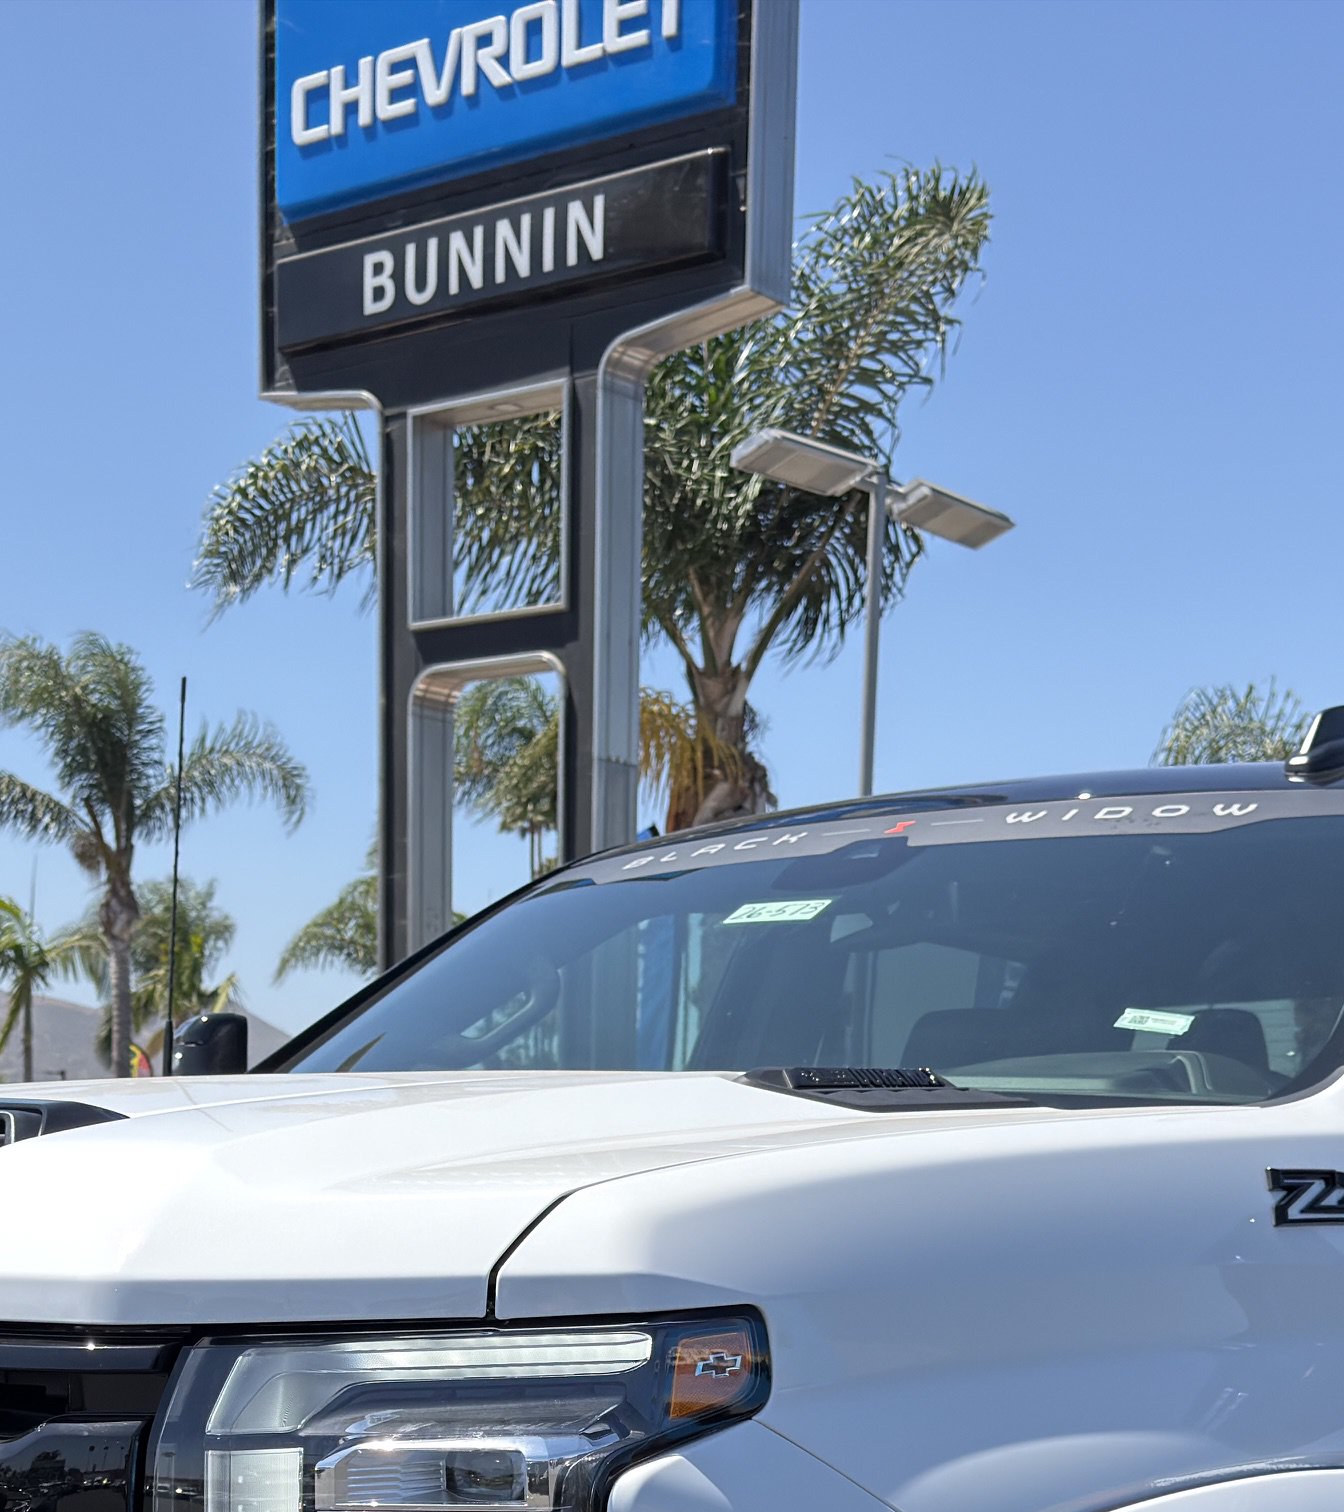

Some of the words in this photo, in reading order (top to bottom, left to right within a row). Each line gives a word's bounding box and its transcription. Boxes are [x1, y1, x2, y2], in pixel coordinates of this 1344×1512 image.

[362, 194, 606, 316] BUNNIN
[622, 832, 808, 870] BLACK
[1005, 803, 1258, 824] WIDOW
